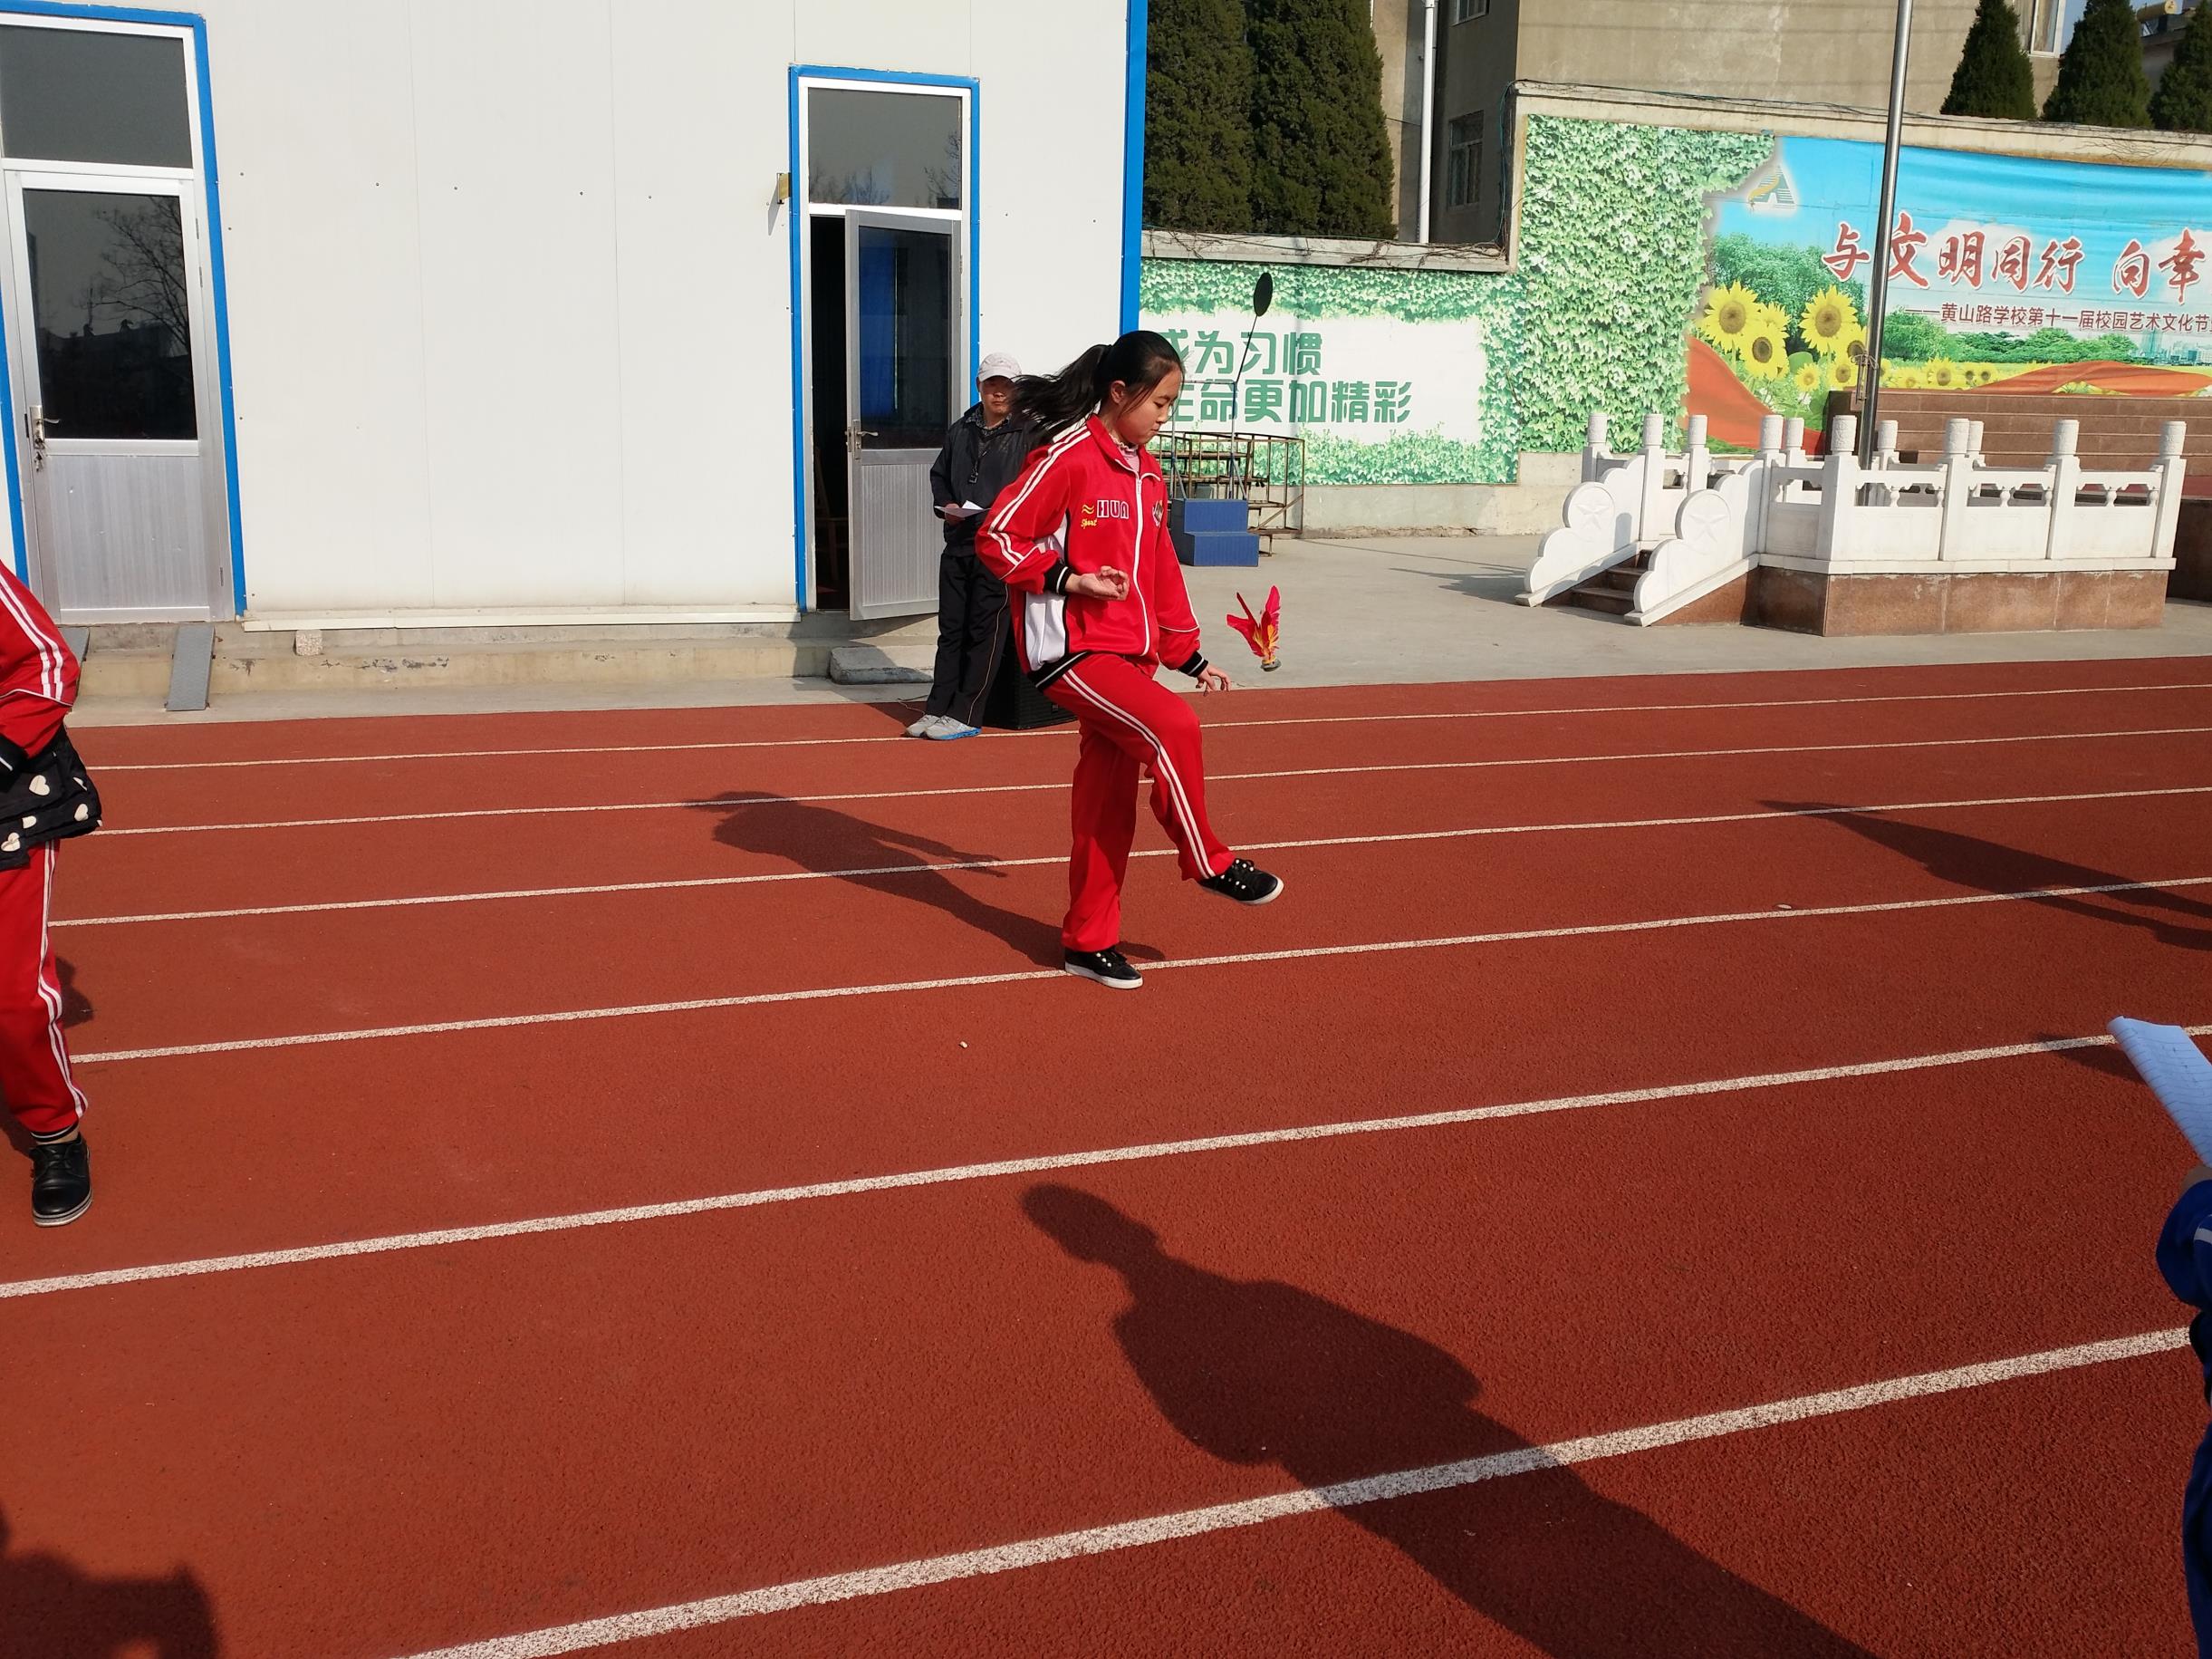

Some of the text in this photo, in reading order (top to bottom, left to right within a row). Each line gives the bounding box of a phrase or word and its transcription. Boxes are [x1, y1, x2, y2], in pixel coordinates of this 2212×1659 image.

[1822, 213, 2206, 304] 与文明同行 向幸
[1905, 302, 2212, 333] ——黄山路学校第十一届校园艺术文化节
